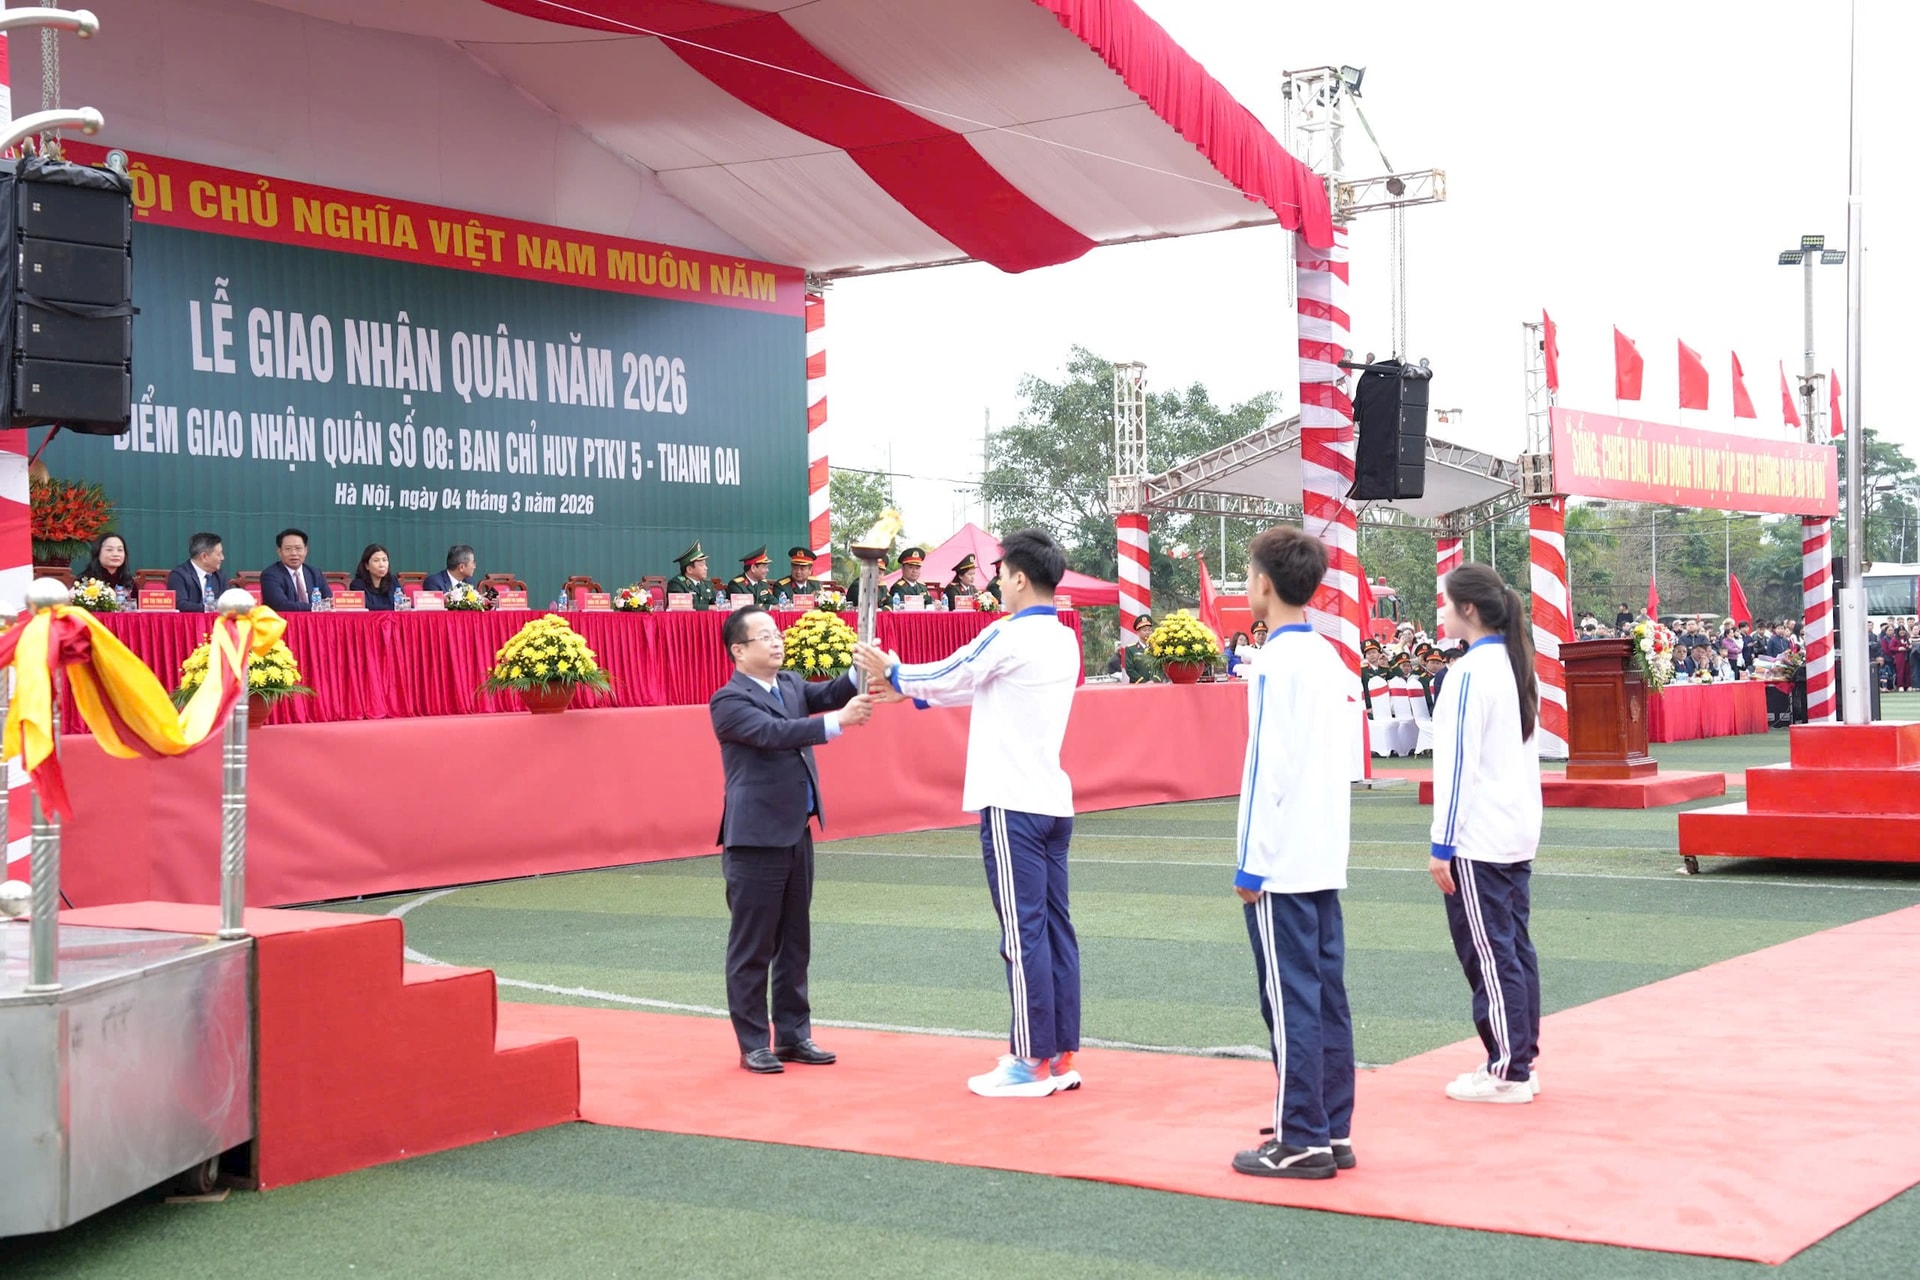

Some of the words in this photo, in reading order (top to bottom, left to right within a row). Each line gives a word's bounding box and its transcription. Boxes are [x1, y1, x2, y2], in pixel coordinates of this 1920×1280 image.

[127, 162, 172, 217] ỘI
[190, 180, 277, 227] CHỦ
[293, 198, 417, 249] NGHĨA
[428, 219, 505, 267] VIỆT
[518, 235, 595, 275] NAM
[608, 250, 699, 290] MUÔN
[710, 262, 776, 303] NĂM
[190, 277, 235, 373] LỄ
[248, 308, 333, 382] GIAO
[345, 311, 441, 405] NHẬN
[452, 324, 537, 403] QUÂN
[546, 333, 614, 408] NĂM
[622, 352, 687, 415] 2026
[187, 408, 243, 458] GIAO
[251, 406, 316, 471] NHẬN
[323, 411, 382, 468] QUÂN
[389, 409, 416, 467] SỐ
[423, 426, 453, 469] 08:
[460, 429, 500, 472] BAN
[506, 420, 537, 474] CHỈ
[543, 435, 577, 476] HUY
[583, 438, 626, 479] PTKV
[631, 442, 642, 480] 5
[657, 443, 710, 483] THANH
[715, 447, 740, 485] OAI
[1652, 440, 1668, 486] LAO
[336, 483, 356, 505] Hà
[362, 484, 394, 510] Nội,
[400, 487, 438, 511] ngày
[442, 488, 461, 509] 04
[466, 490, 507, 513] tháng
[512, 492, 521, 511] 3
[525, 492, 555, 512] năm
[560, 494, 593, 514] 2026
